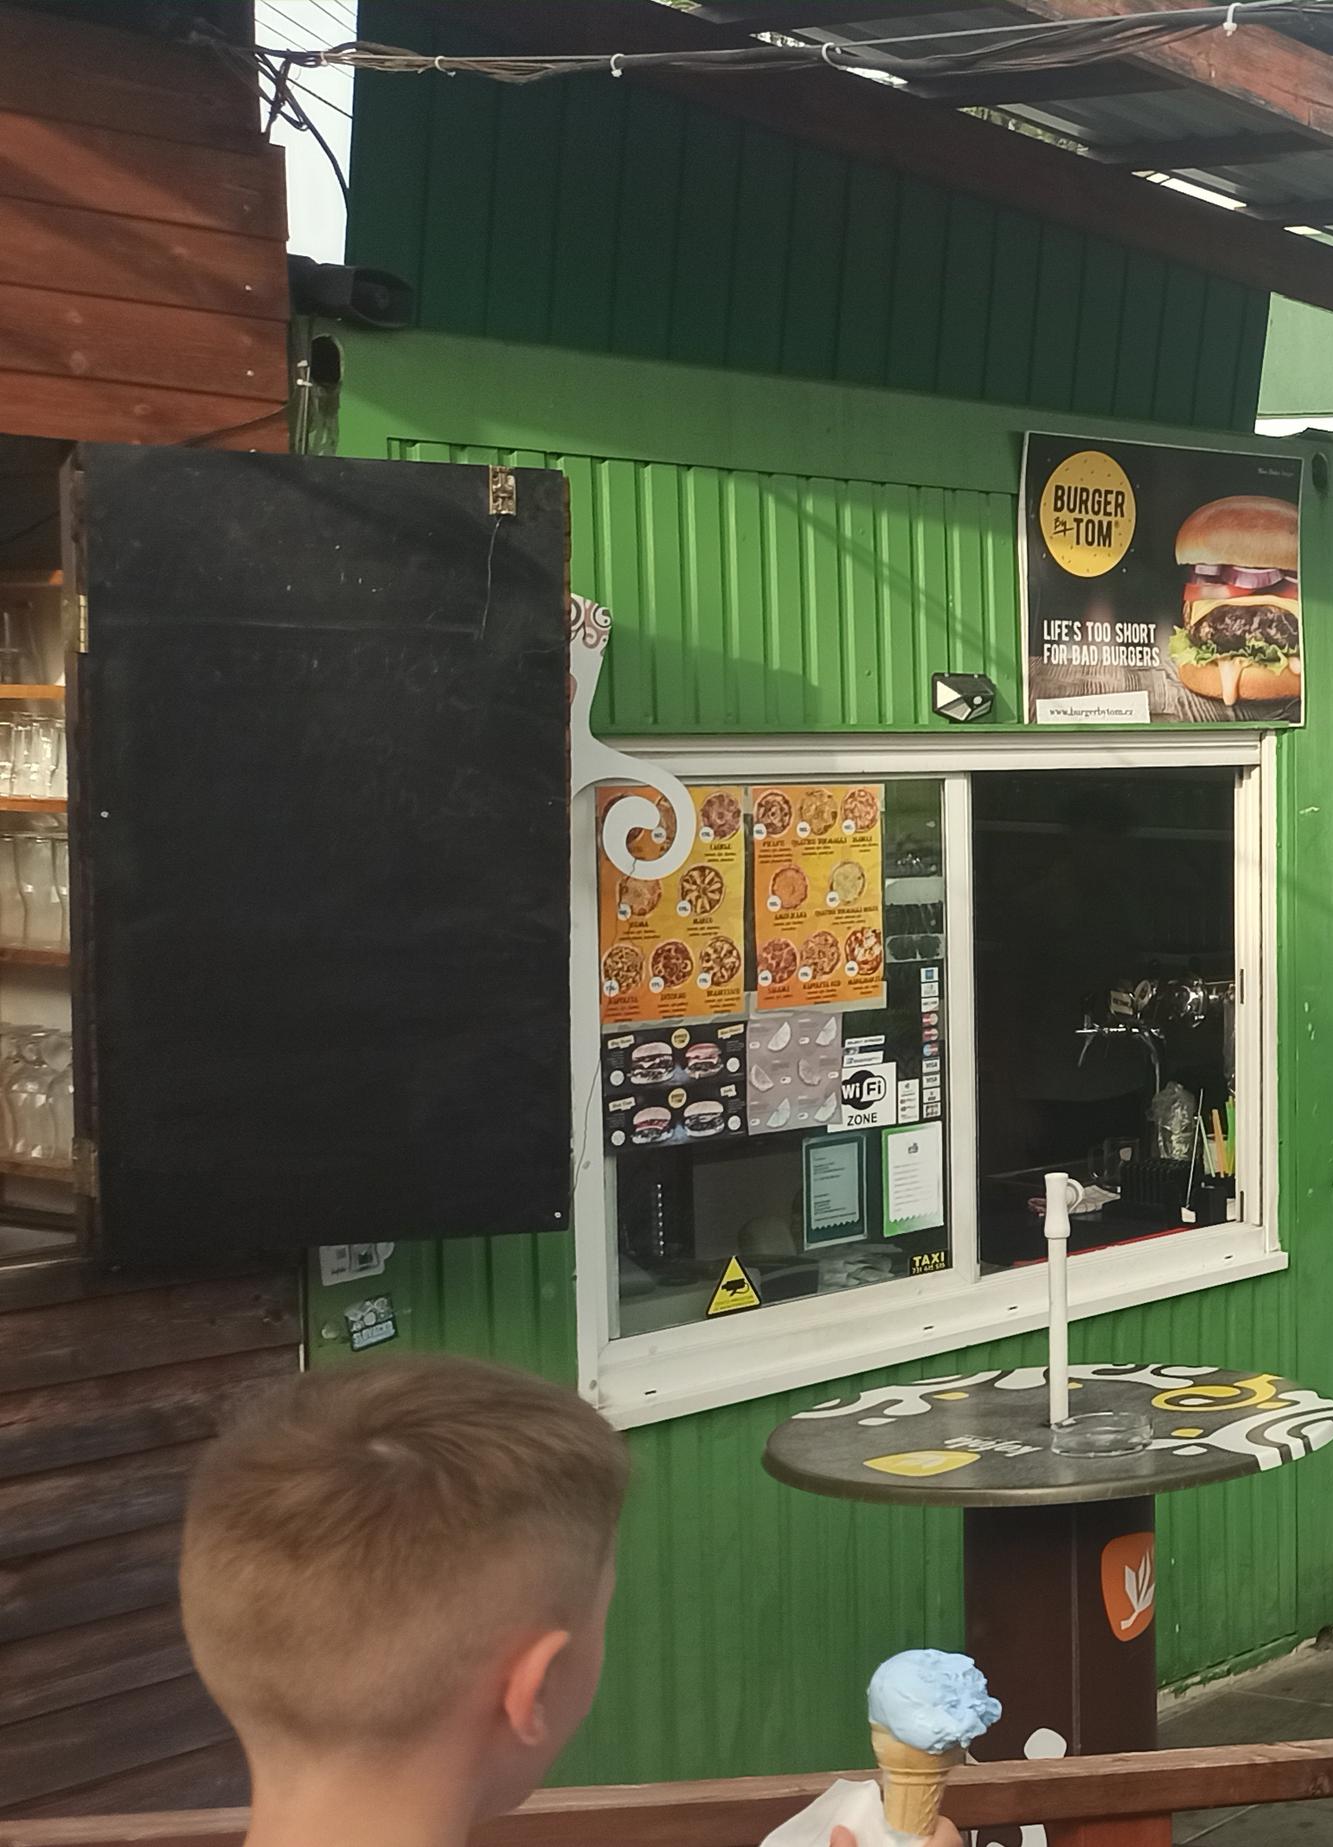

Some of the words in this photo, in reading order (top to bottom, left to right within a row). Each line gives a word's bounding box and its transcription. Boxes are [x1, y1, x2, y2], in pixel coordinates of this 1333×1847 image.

[1054, 485, 1125, 518] BURGER
[1073, 518, 1113, 547] TOM
[1043, 620, 1082, 641] LIFE'S
[1087, 622, 1111, 642] TOO
[1115, 623, 1156, 644] SHORT
[1043, 644, 1067, 664] FOR
[1072, 645, 1097, 665] BAD
[1103, 646, 1160, 666] BURGERS
[847, 1113, 877, 1126] ZONE
[912, 1252, 945, 1265] TAXI
